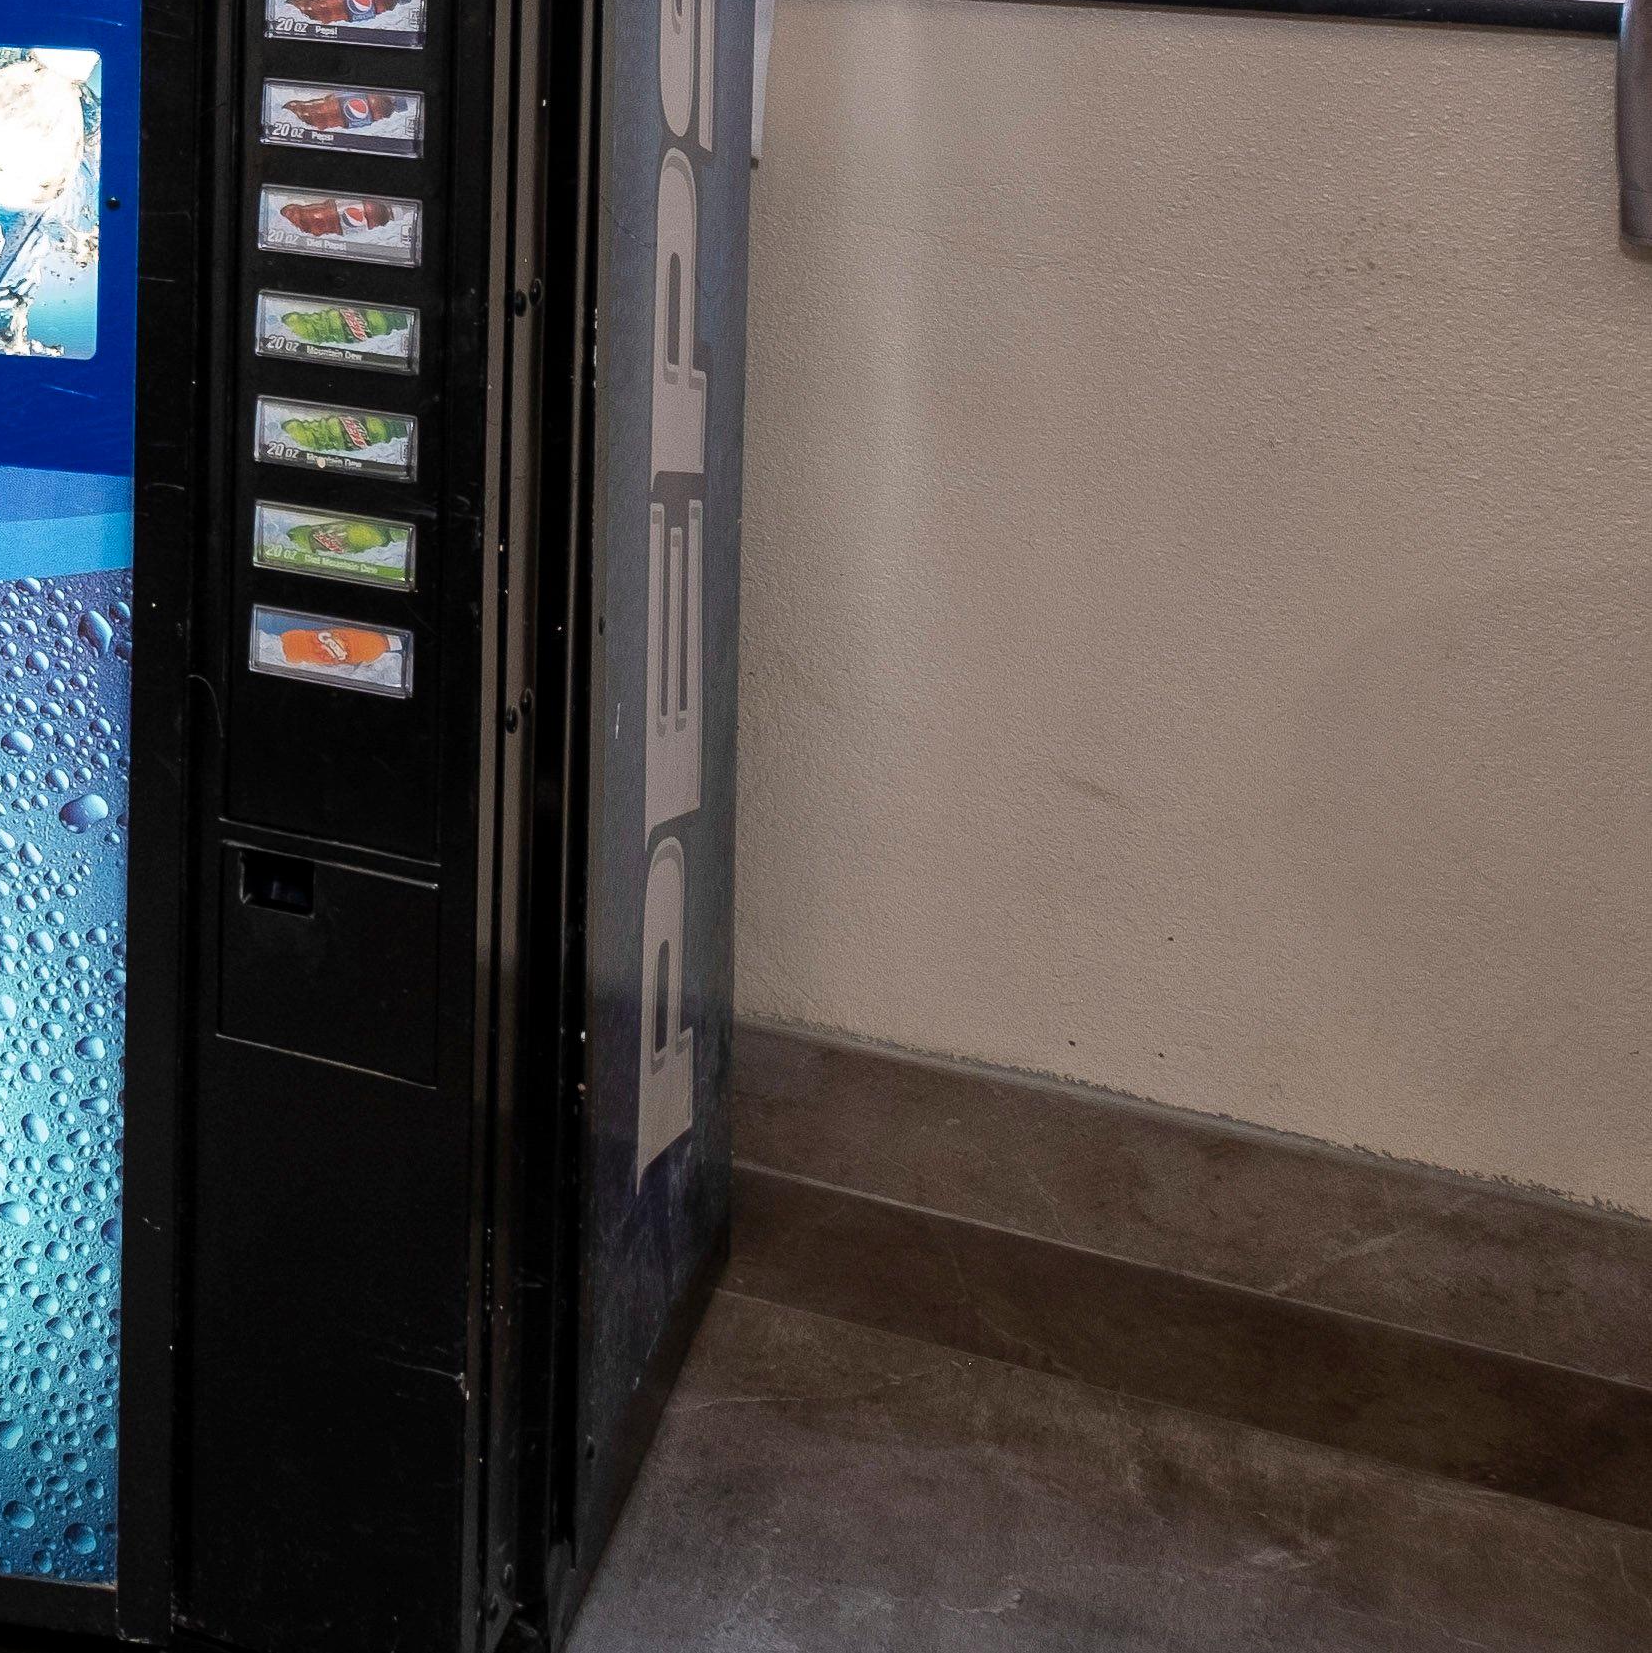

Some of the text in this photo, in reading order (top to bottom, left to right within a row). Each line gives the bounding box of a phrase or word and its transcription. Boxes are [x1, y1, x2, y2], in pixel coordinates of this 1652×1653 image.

[275, 17, 293, 31] 20
[315, 25, 338, 36] Pepsi
[271, 123, 290, 137] 20
[311, 131, 334, 142] Pepsi
[267, 229, 285, 242] 20
[266, 335, 285, 349] 20
[307, 345, 343, 359] Mountain
[345, 351, 363, 361] Dew
[266, 442, 285, 456] 20
[265, 544, 283, 558] 20
[322, 557, 359, 571] Mountain
[360, 562, 378, 574] Dew
